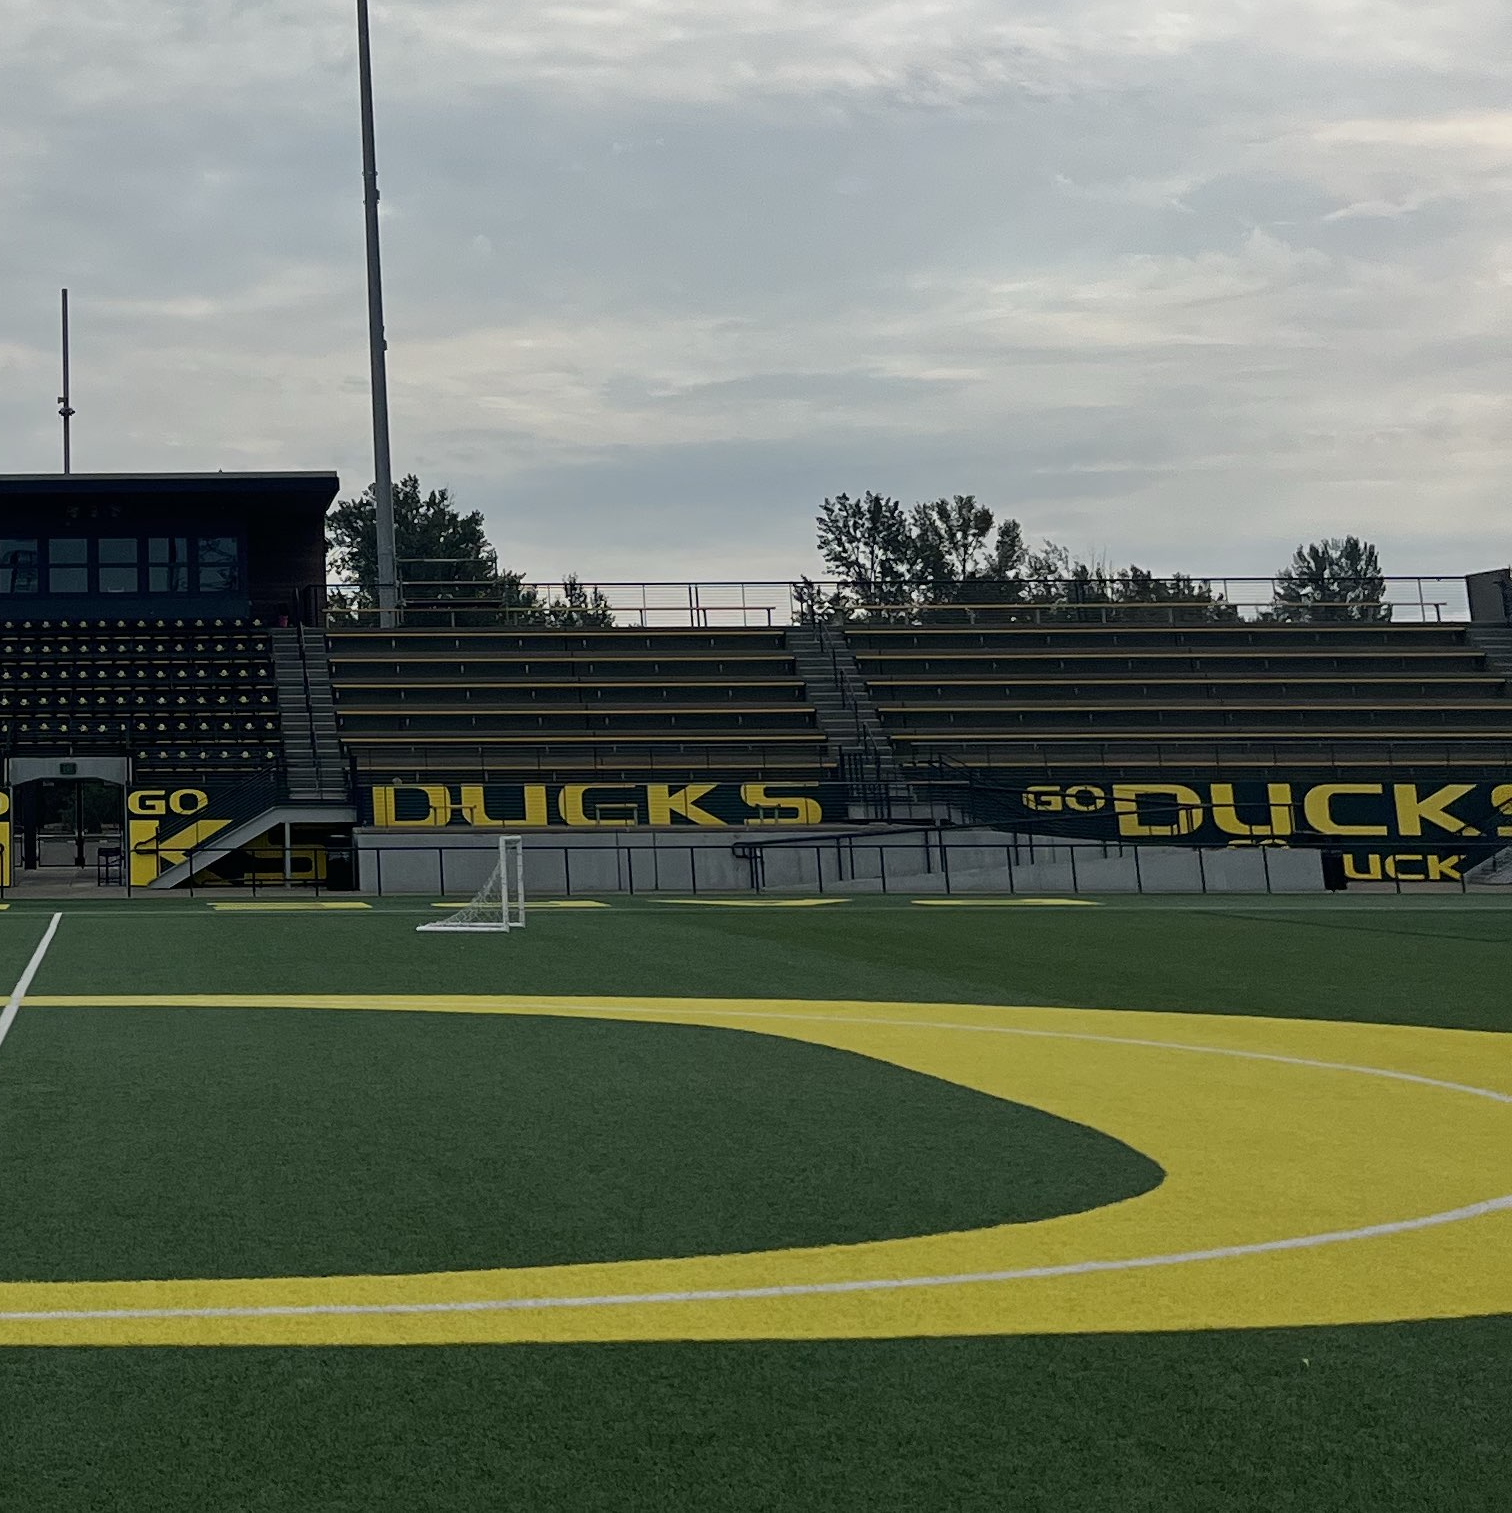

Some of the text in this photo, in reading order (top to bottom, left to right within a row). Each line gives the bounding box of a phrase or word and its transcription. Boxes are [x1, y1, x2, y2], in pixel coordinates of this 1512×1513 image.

[127, 788, 209, 816] GO
[372, 782, 823, 828] DUCKS
[1023, 785, 1106, 812] GO
